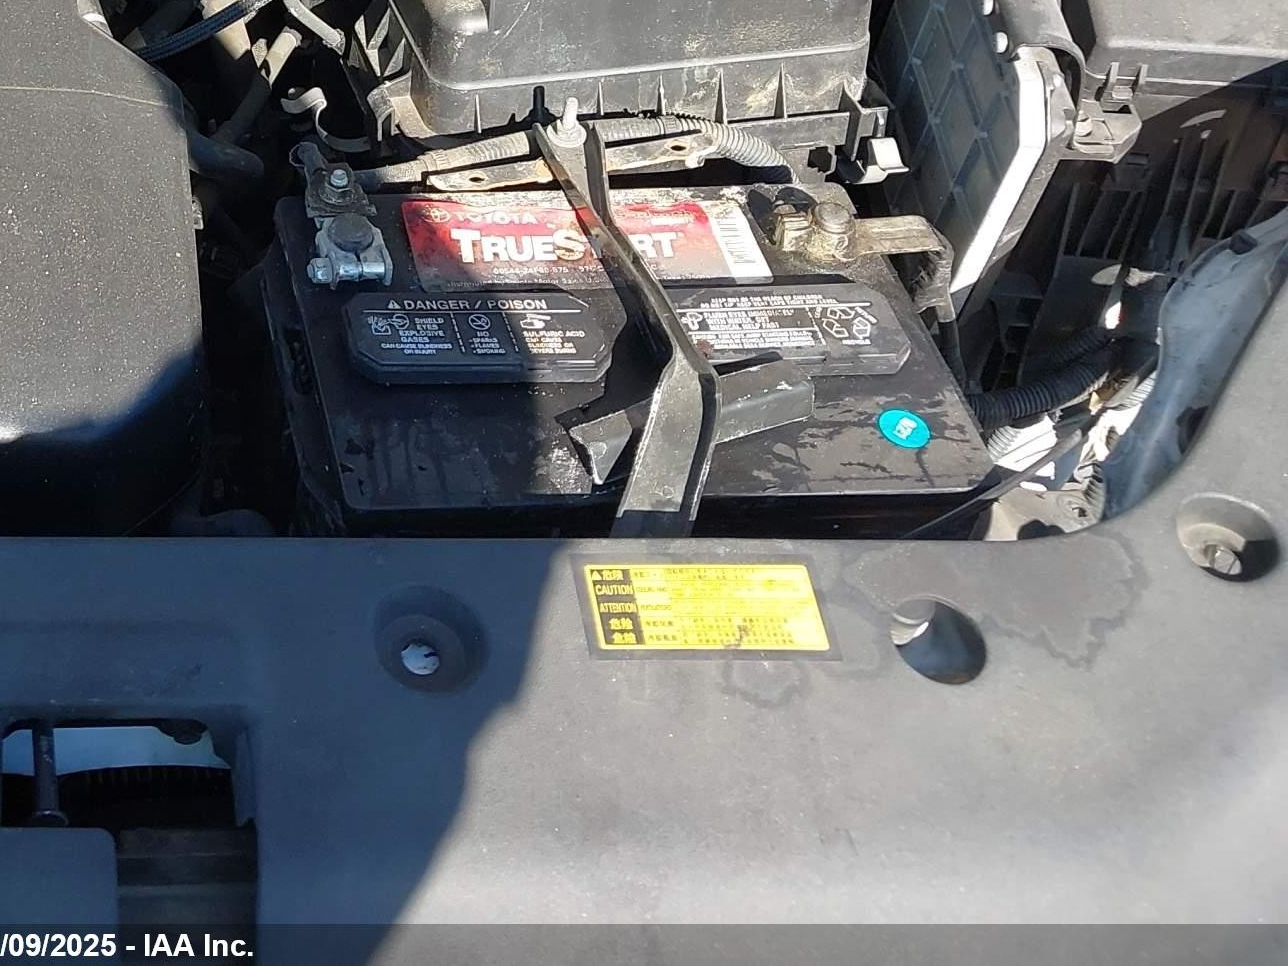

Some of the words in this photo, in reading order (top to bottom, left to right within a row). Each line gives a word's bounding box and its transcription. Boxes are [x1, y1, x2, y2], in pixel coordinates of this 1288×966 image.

[455, 211, 538, 225] TOYOTA
[450, 228, 678, 264] TRUESRT
[403, 299, 470, 310] DANGER
[487, 299, 548, 310] POISON
[595, 584, 634, 596] CAUTION
[599, 602, 638, 613] ATTENTION
